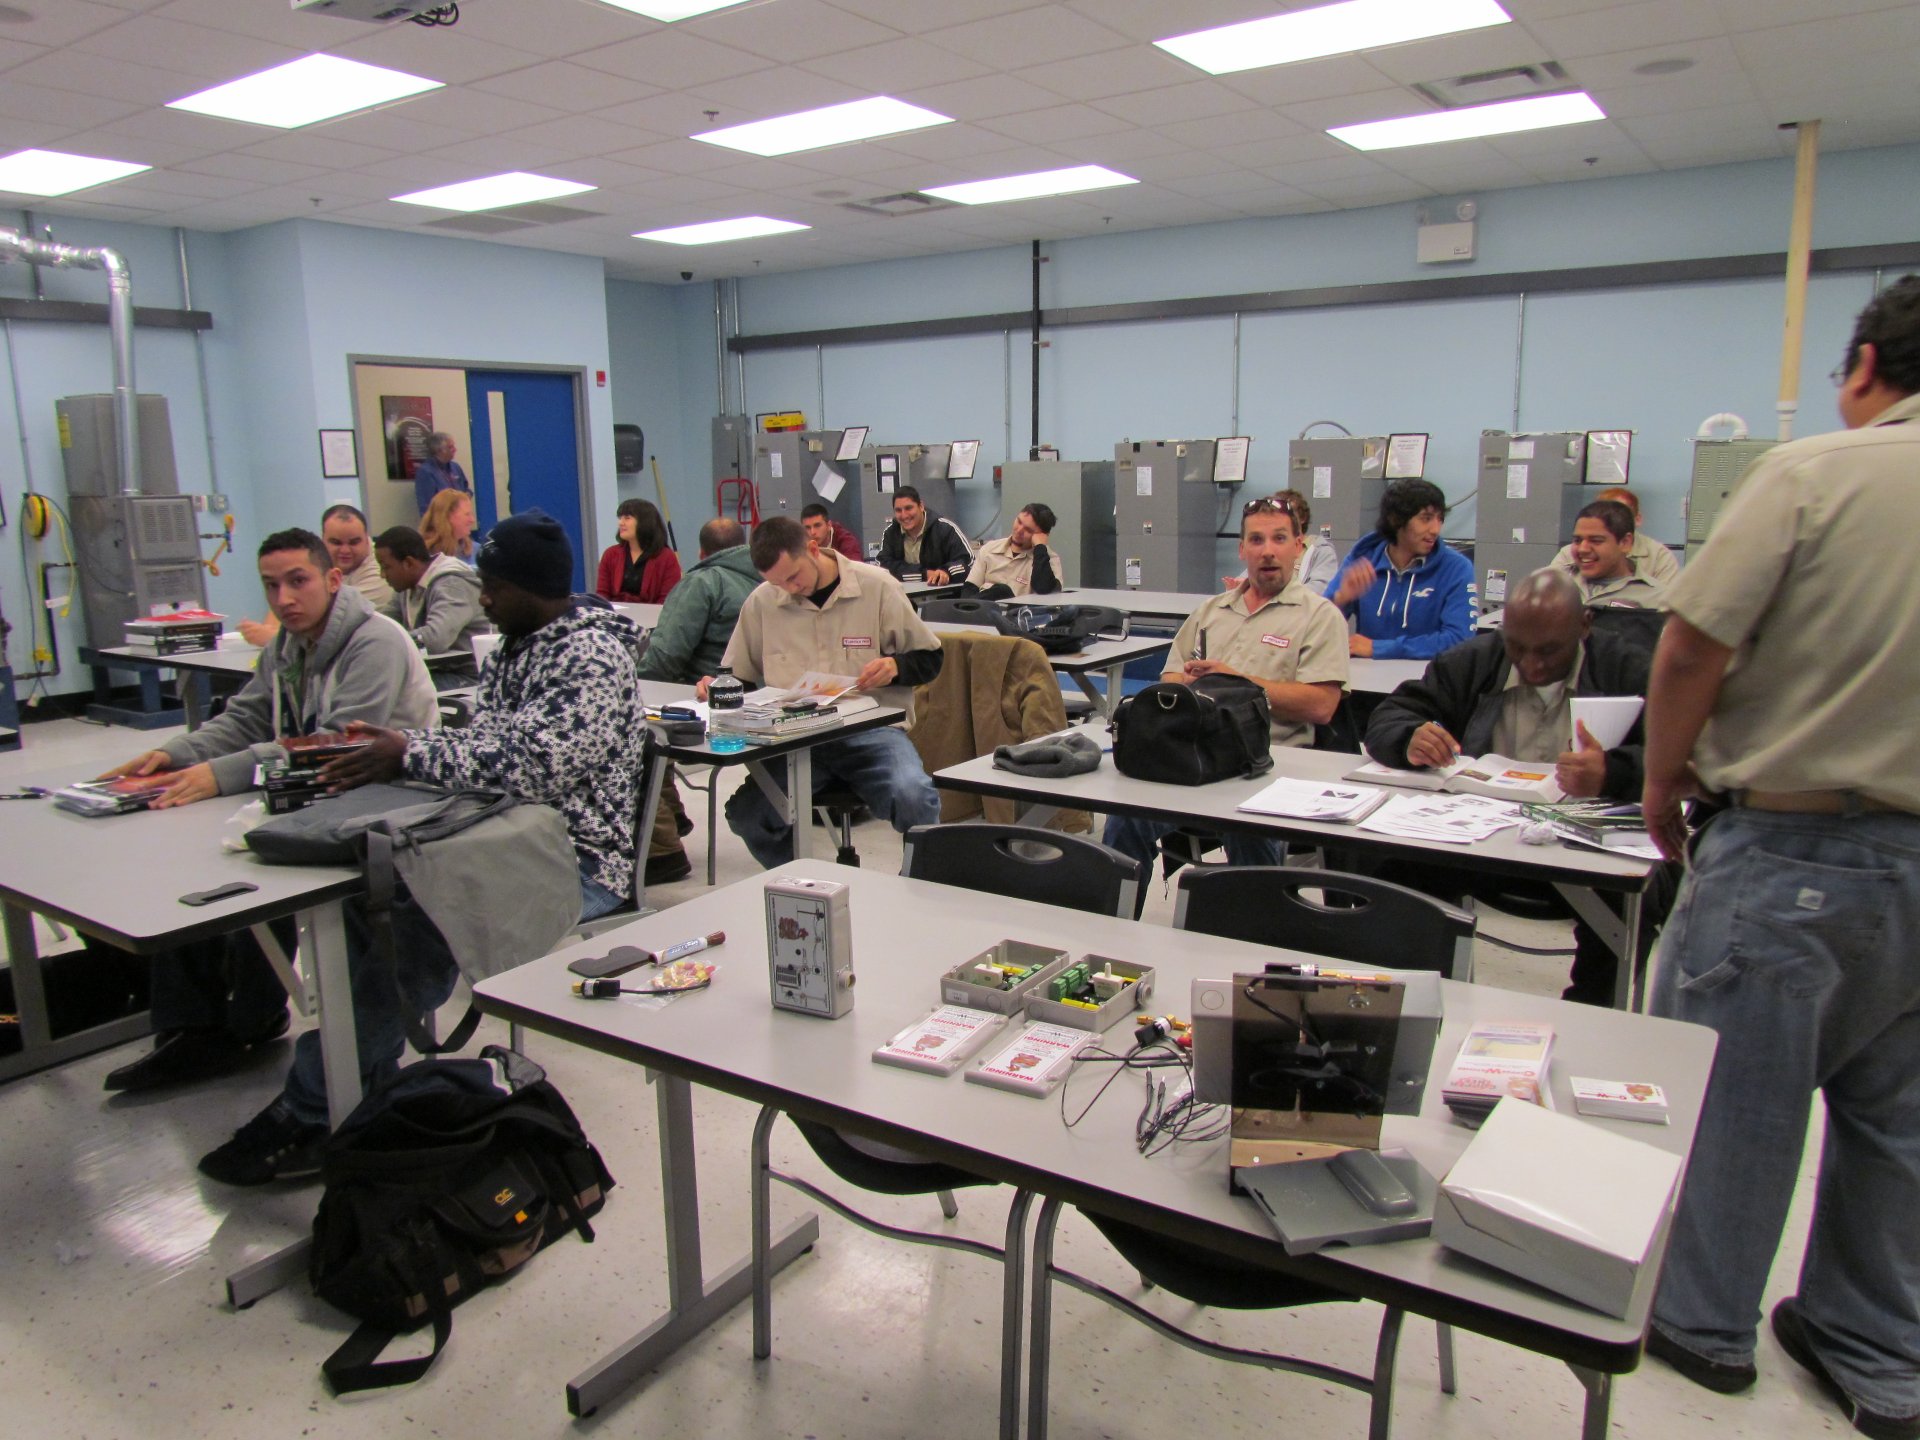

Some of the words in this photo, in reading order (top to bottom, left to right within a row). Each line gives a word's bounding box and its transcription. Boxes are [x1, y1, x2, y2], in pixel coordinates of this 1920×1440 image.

[931, 1017, 976, 1030] WARNING!
[1024, 1035, 1070, 1049] WARNING!
[891, 1047, 938, 1061] WARNING!
[985, 1066, 1034, 1082] WARNING!
